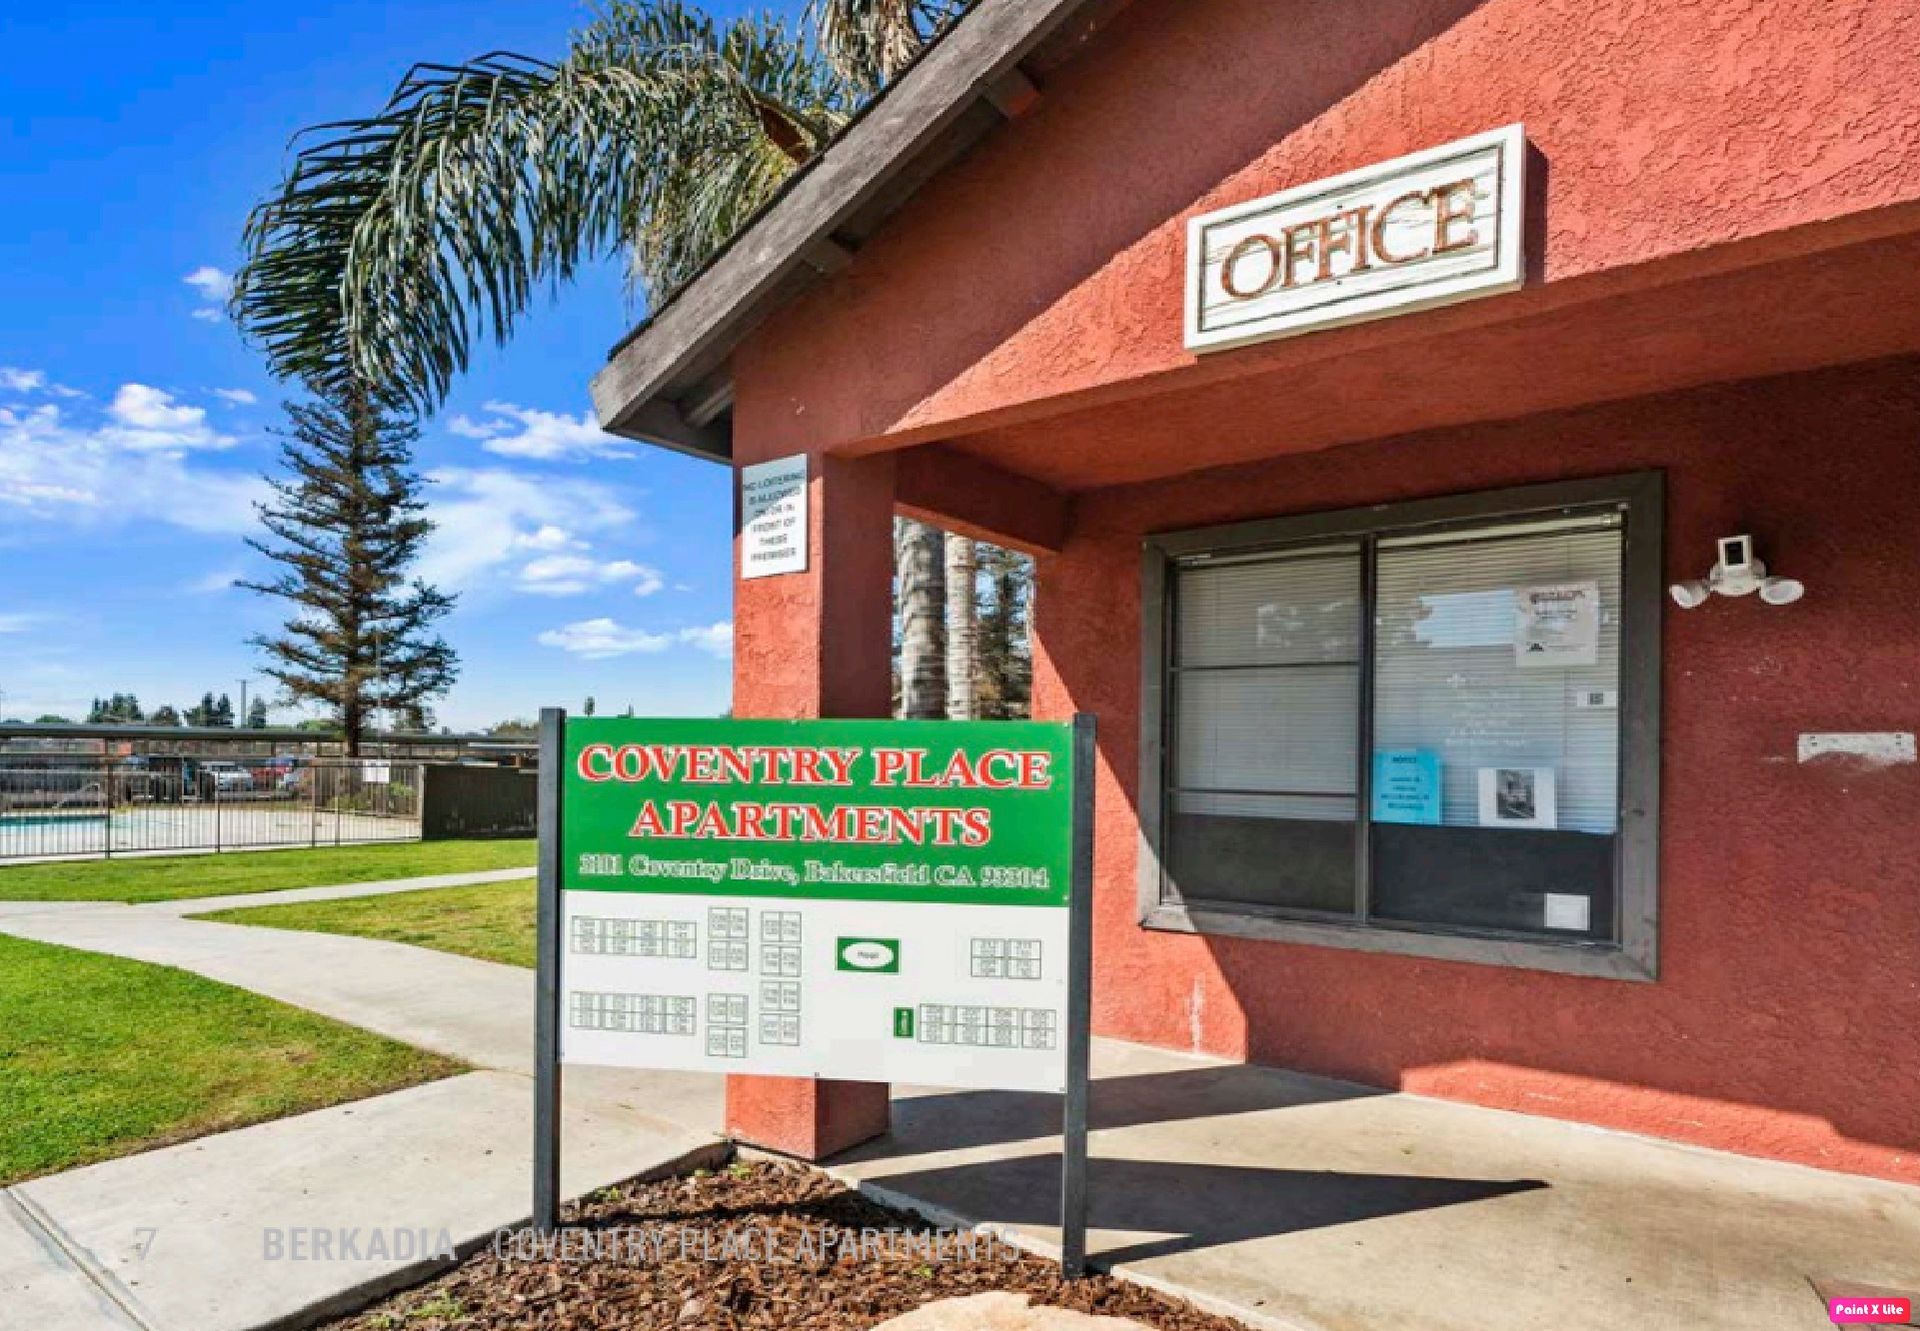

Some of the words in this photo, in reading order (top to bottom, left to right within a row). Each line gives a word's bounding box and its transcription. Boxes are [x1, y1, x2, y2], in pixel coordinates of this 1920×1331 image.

[1221, 178, 1479, 300] OFFICE
[758, 470, 805, 489] LOITERING
[577, 744, 860, 786] COVENTRY
[871, 748, 1052, 789] PLACE
[627, 800, 992, 846] APARTMENTS
[629, 854, 728, 883] Coventry
[730, 858, 799, 886] Drive,
[804, 859, 931, 885] Bakersfield
[934, 865, 976, 886] CA
